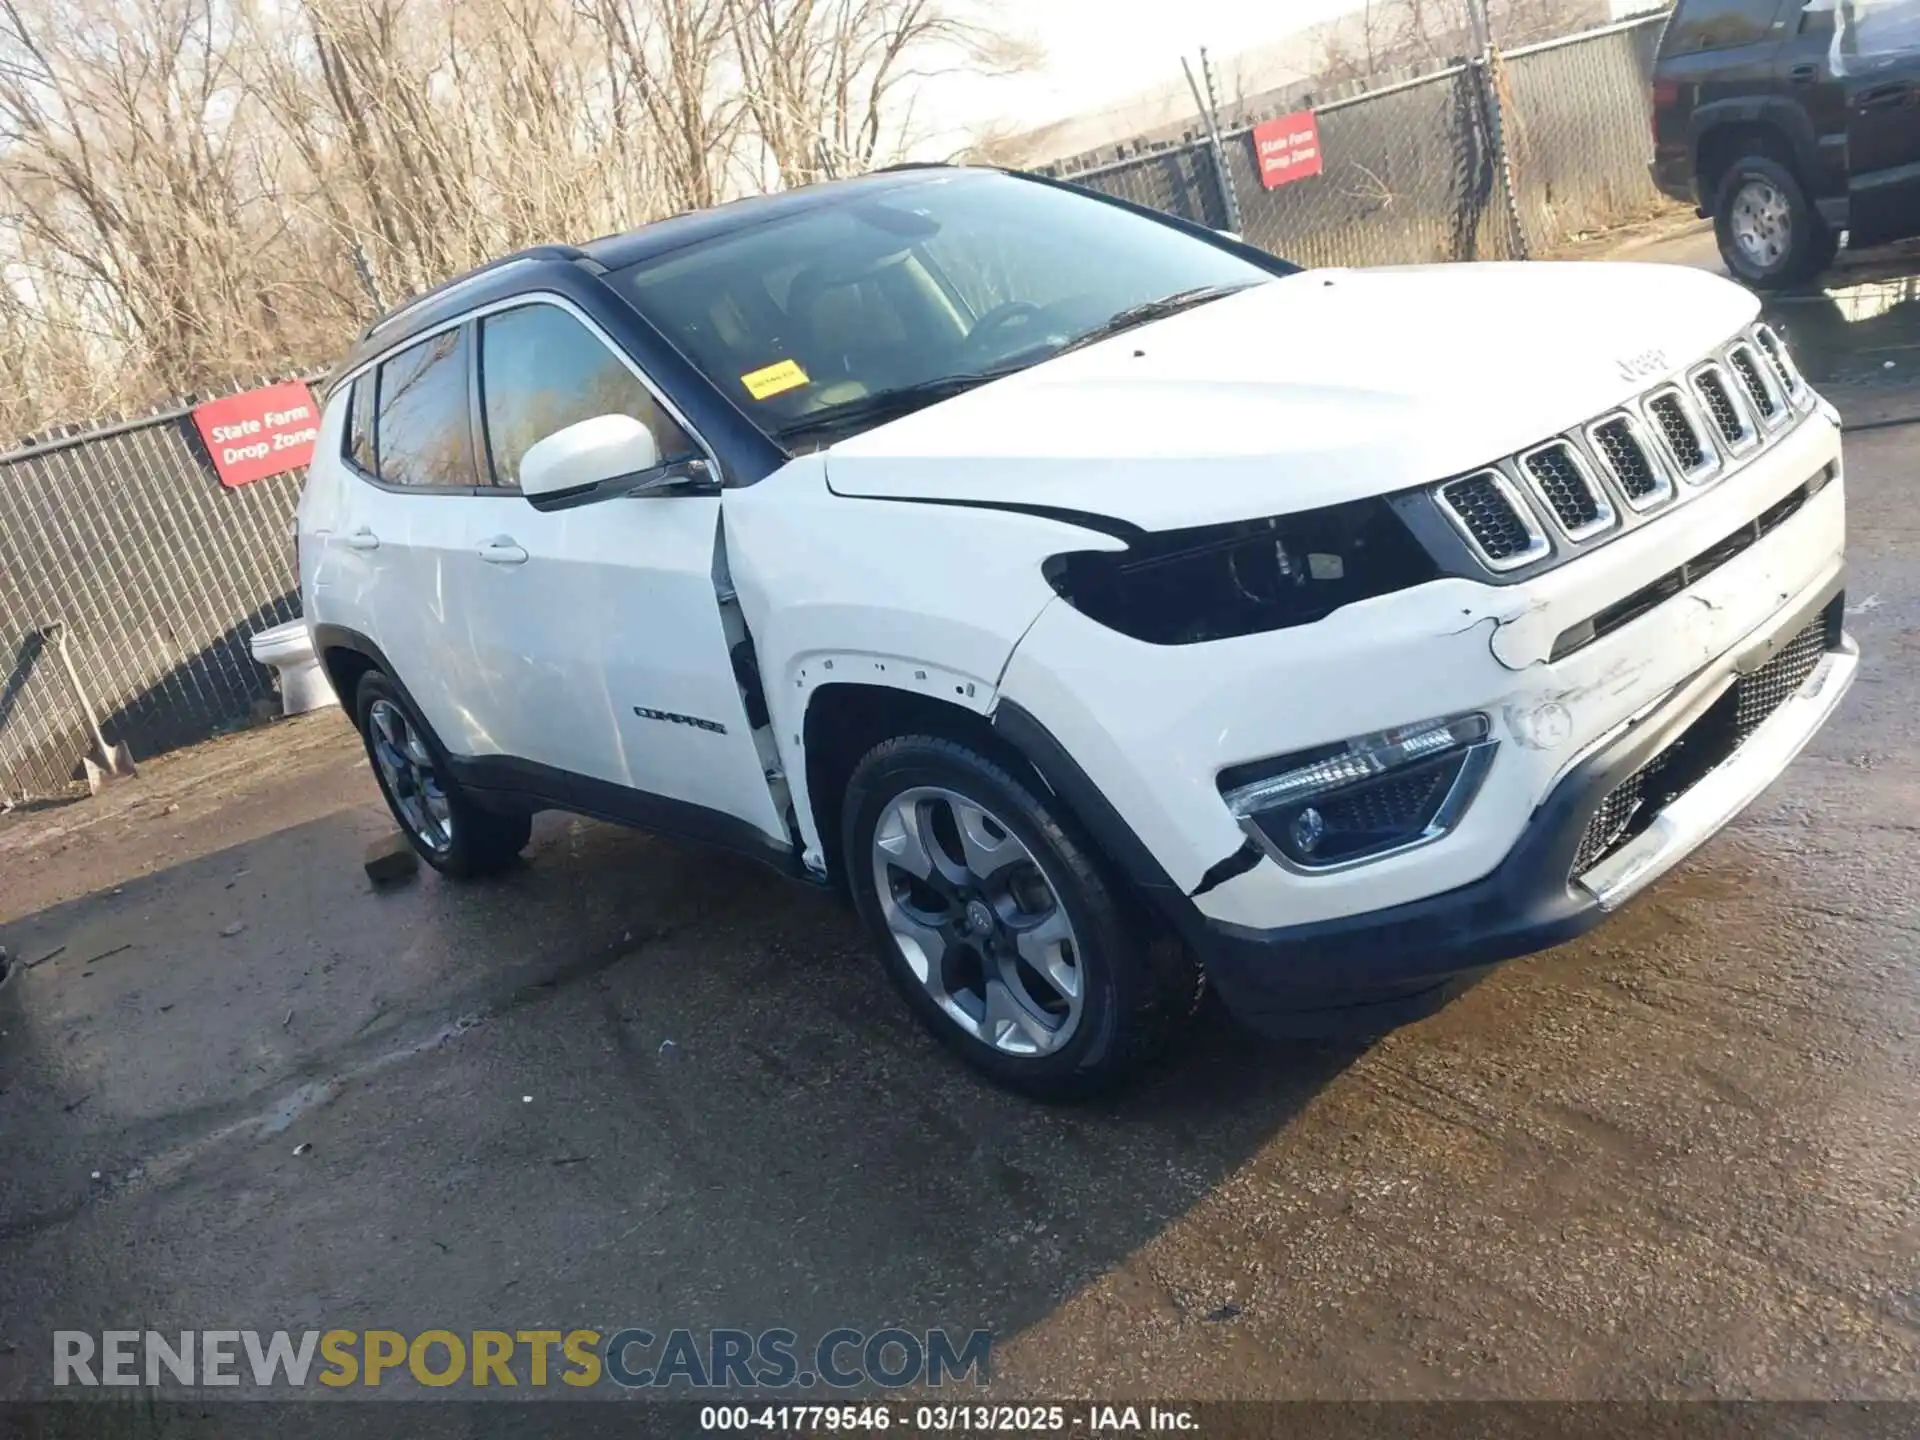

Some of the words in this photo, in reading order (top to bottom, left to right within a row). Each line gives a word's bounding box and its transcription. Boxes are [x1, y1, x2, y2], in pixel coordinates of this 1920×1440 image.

[211, 420, 261, 443] State
[263, 406, 310, 429] Farm
[223, 442, 269, 465] Drop
[271, 428, 317, 450] Zone
